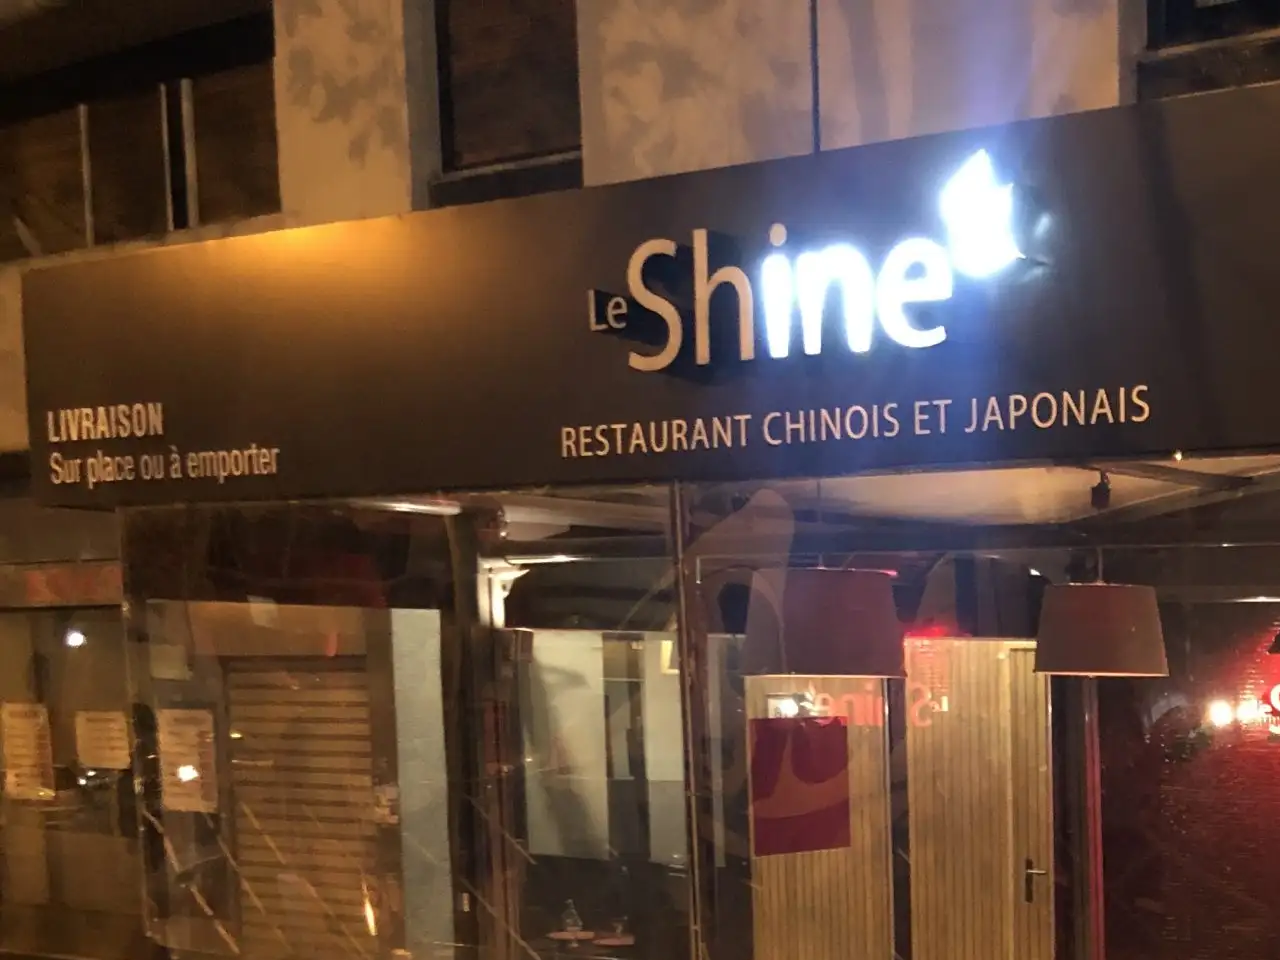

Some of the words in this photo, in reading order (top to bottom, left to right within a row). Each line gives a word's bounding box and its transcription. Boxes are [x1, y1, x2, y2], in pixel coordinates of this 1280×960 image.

[588, 289, 628, 331] Le
[627, 222, 955, 372] Shine
[47, 402, 164, 443] LIVRAISON
[561, 413, 753, 458] RESTAURANT
[762, 402, 900, 447] CHINOIS
[914, 399, 953, 436] ET
[964, 384, 1151, 435] JAPONAIS
[50, 451, 82, 485] Sur
[87, 449, 136, 489] place
[140, 453, 165, 481] ou
[169, 444, 184, 479] à
[187, 442, 281, 484] emporter
